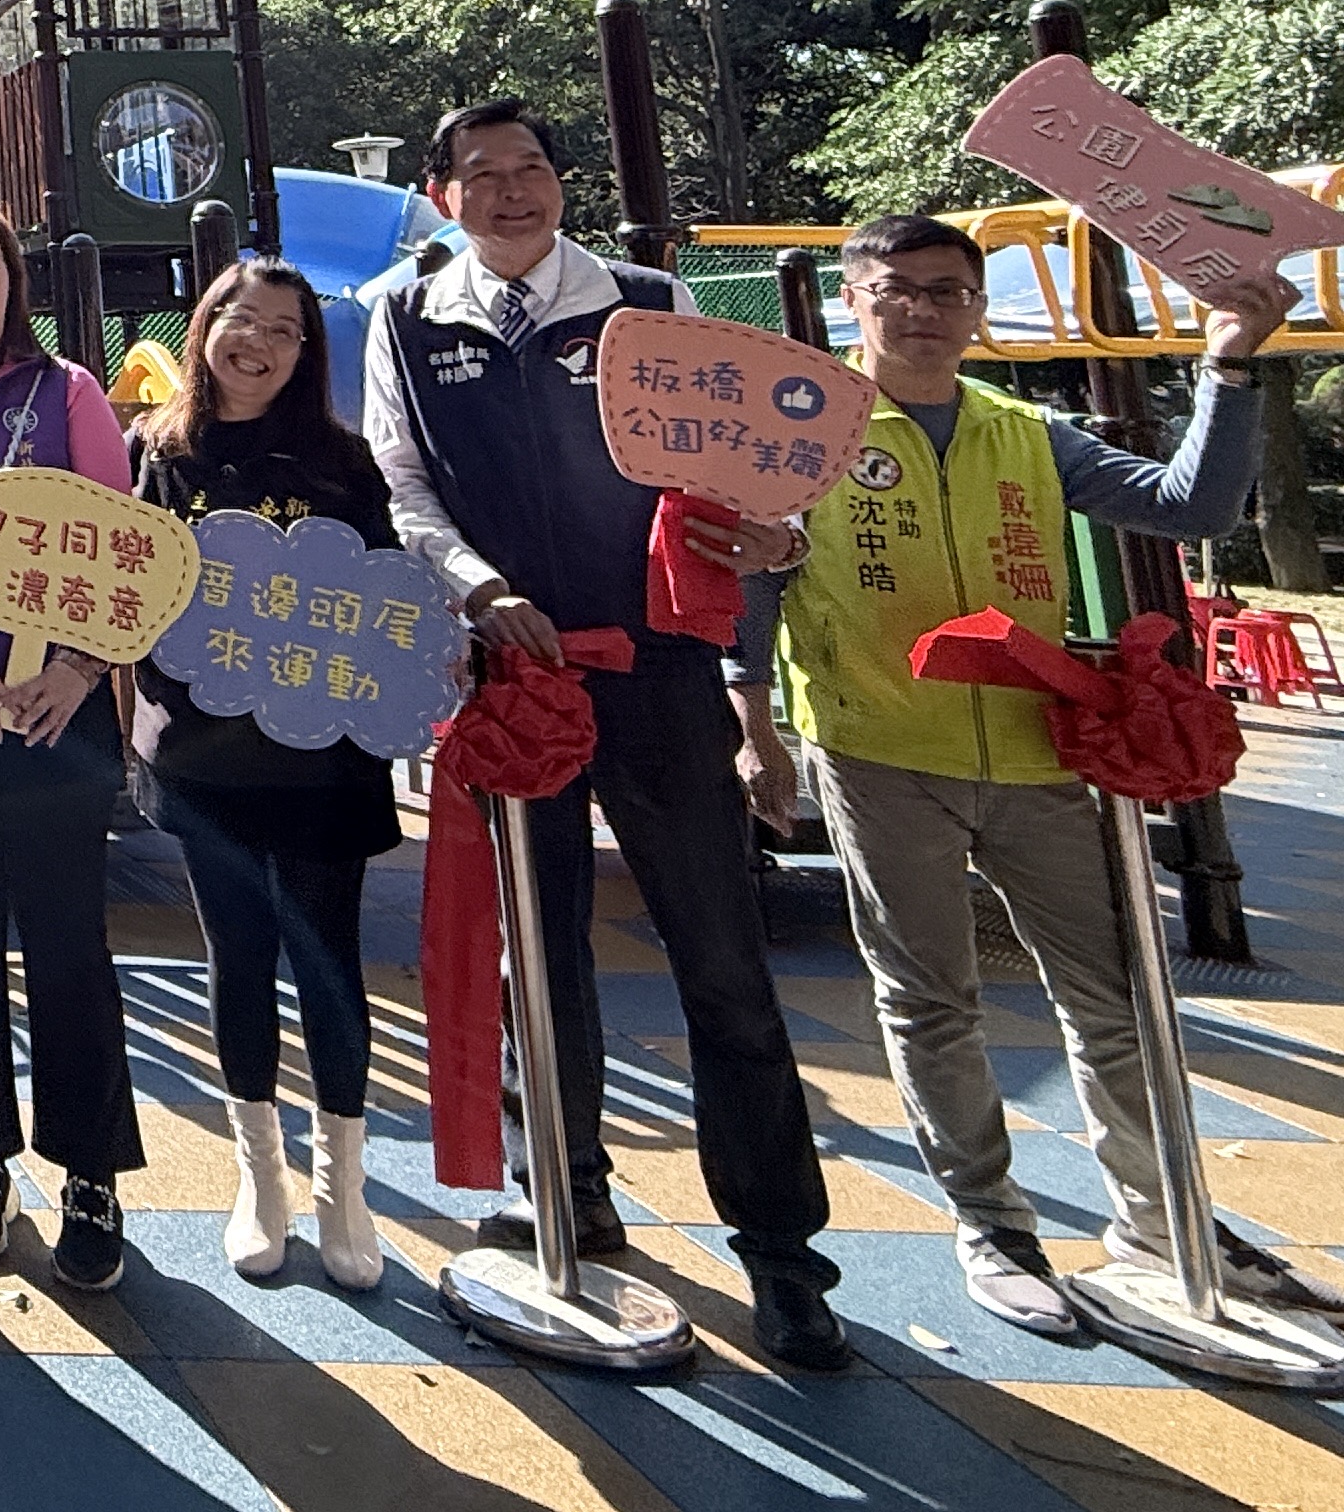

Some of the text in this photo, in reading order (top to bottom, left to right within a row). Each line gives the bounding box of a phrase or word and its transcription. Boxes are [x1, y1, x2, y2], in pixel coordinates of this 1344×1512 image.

[1030, 104, 1143, 169] 公園
[1095, 176, 1242, 286] 健身房
[629, 358, 745, 405] 板橋
[622, 406, 827, 481] 公園好美麗
[848, 495, 896, 593] 沈中皓
[893, 498, 921, 539] 特助
[200, 557, 422, 651] 厝邊頭尾
[206, 627, 381, 702] 來運動
